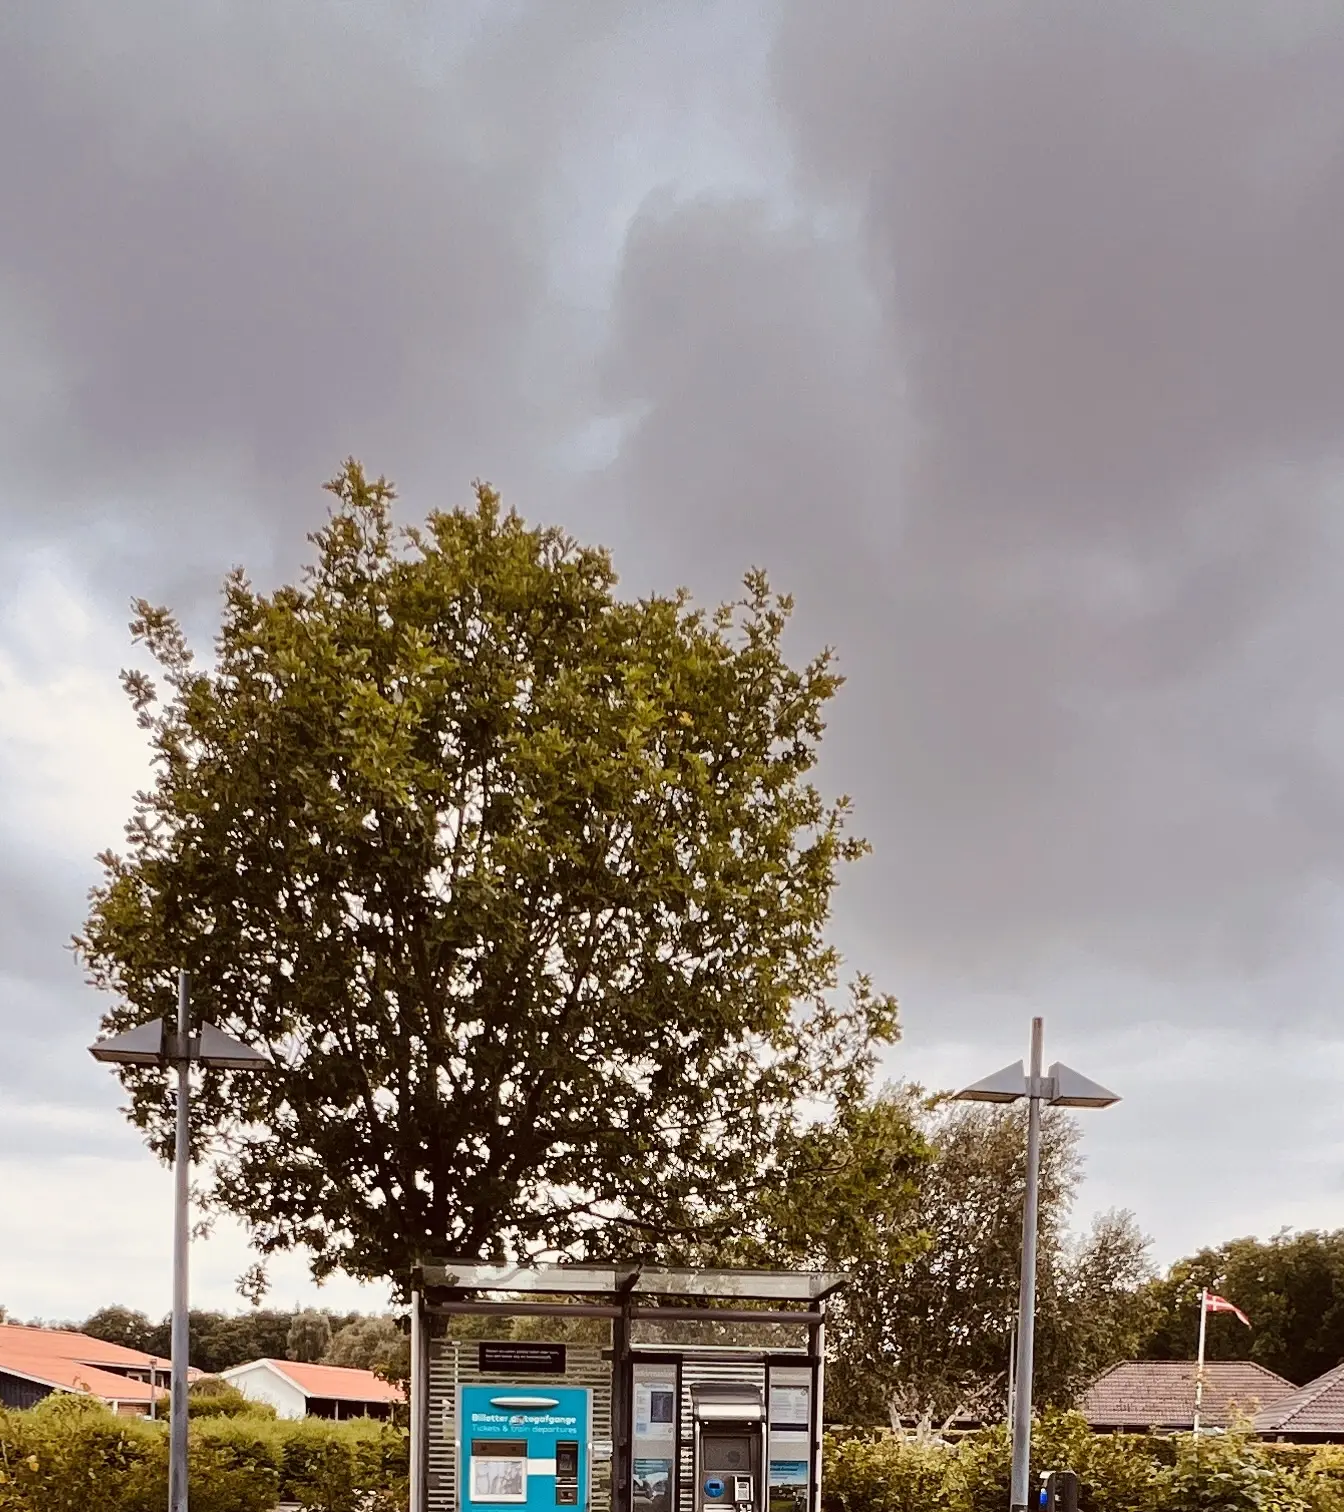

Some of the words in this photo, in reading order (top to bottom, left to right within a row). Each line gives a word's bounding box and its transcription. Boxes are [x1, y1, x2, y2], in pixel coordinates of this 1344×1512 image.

[471, 1413, 508, 1423] Billetter
[472, 1424, 501, 1432] Tickets
[510, 1425, 531, 1433] train
[532, 1425, 577, 1434] departures
